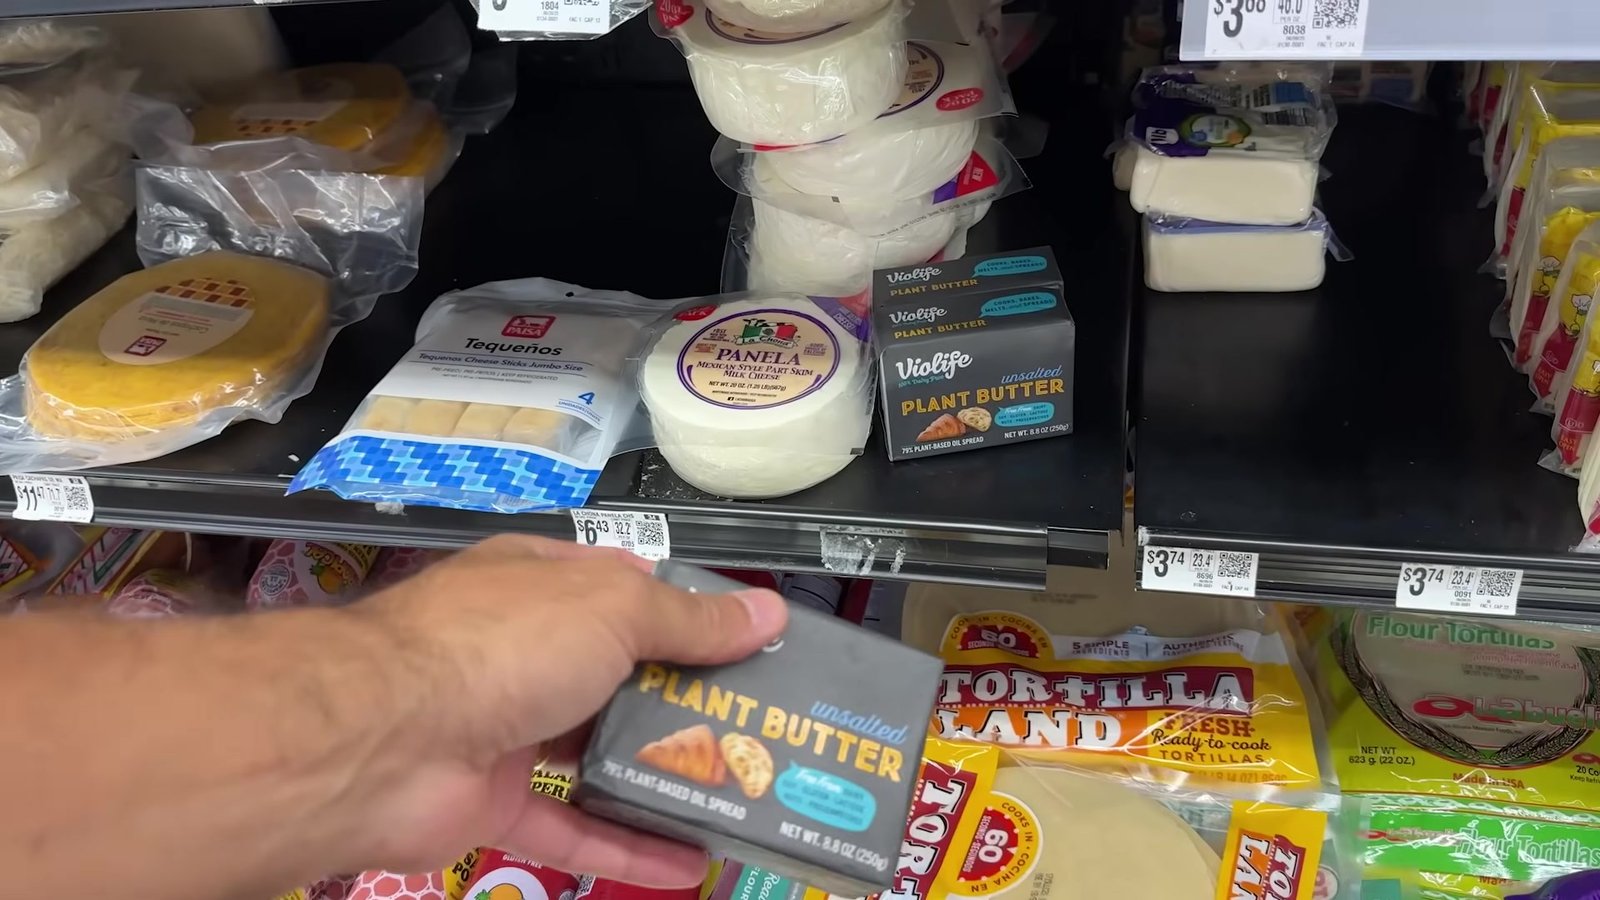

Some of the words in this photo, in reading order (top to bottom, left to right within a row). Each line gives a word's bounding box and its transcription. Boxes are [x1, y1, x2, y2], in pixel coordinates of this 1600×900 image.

[541, 1, 559, 10] 1804
[1283, 25, 1306, 35] 8038
[886, 266, 943, 283] Violife
[890, 285, 927, 296] PLANT
[931, 279, 978, 291] BUTTER
[889, 306, 948, 324] Violife
[506, 326, 541, 337] PAISA
[894, 327, 934, 339] PLANT
[938, 320, 988, 333] BUTTER
[464, 337, 563, 356] Tequeños
[759, 334, 792, 348] Chona
[465, 357, 499, 366] Cheese
[501, 359, 528, 367] Sticks
[529, 361, 562, 370] Jumbo
[564, 364, 584, 372] Size
[716, 348, 802, 367] PANELA
[896, 350, 973, 380] Violife
[696, 361, 735, 371] MEXICAN
[737, 363, 764, 373] STYLE
[765, 365, 788, 375] PART
[790, 367, 813, 377] SKIM
[723, 370, 747, 378] MILK
[748, 371, 781, 381] CHEESE
[1001, 365, 1062, 384] unsalted
[578, 392, 595, 405] 4
[902, 391, 970, 416] PLANT
[976, 379, 1065, 405] BUTTER
[1018, 430, 1029, 438] WT.
[1029, 427, 1040, 436] 8.8
[1040, 426, 1049, 434] OZ
[1049, 423, 1069, 433] (250g)
[902, 446, 914, 454] 79%
[914, 441, 952, 453] PLANT-BASED
[952, 439, 962, 447] OIL
[962, 436, 985, 446] SPREAD
[981, 629, 1017, 648] 60
[1368, 616, 1440, 641] Flour
[1445, 622, 1556, 650] Tortillas
[1083, 641, 1129, 650] SIMPLE
[939, 668, 1252, 713] TORTILLA
[638, 665, 759, 727] PLANT
[761, 706, 905, 783] BUTTER
[810, 700, 910, 745] unsalted
[935, 708, 1123, 749] LAND
[1163, 712, 1253, 738] FRESH
[1151, 728, 1272, 753] Ready-to-cook
[1160, 750, 1264, 763] TORTILLAS
[1361, 746, 1378, 754] NET
[1381, 746, 1397, 755] WT
[1349, 756, 1367, 764] 623
[1379, 755, 1394, 765] (22
[1396, 756, 1415, 766] OZ.)
[1576, 765, 1586, 773] 20
[1453, 773, 1483, 784] Made
[1501, 779, 1525, 789] USA
[624, 767, 690, 801] PLANT-BASED
[689, 790, 706, 806] OIL
[706, 796, 748, 820] SPREAD
[1001, 802, 1030, 828] COOKS
[1025, 831, 1033, 842] IN
[779, 821, 801, 840] NET
[802, 828, 821, 847] WT.
[821, 834, 841, 852] 8.8
[840, 840, 855, 857] OZ
[854, 845, 889, 874] (250g)
[978, 829, 1009, 863] 60
[1517, 836, 1600, 866] Tortillas
[502, 853, 526, 864] GLUTEN
[527, 859, 543, 869] FREE
[993, 852, 1029, 885] COCINA
[971, 883, 988, 893] EN
